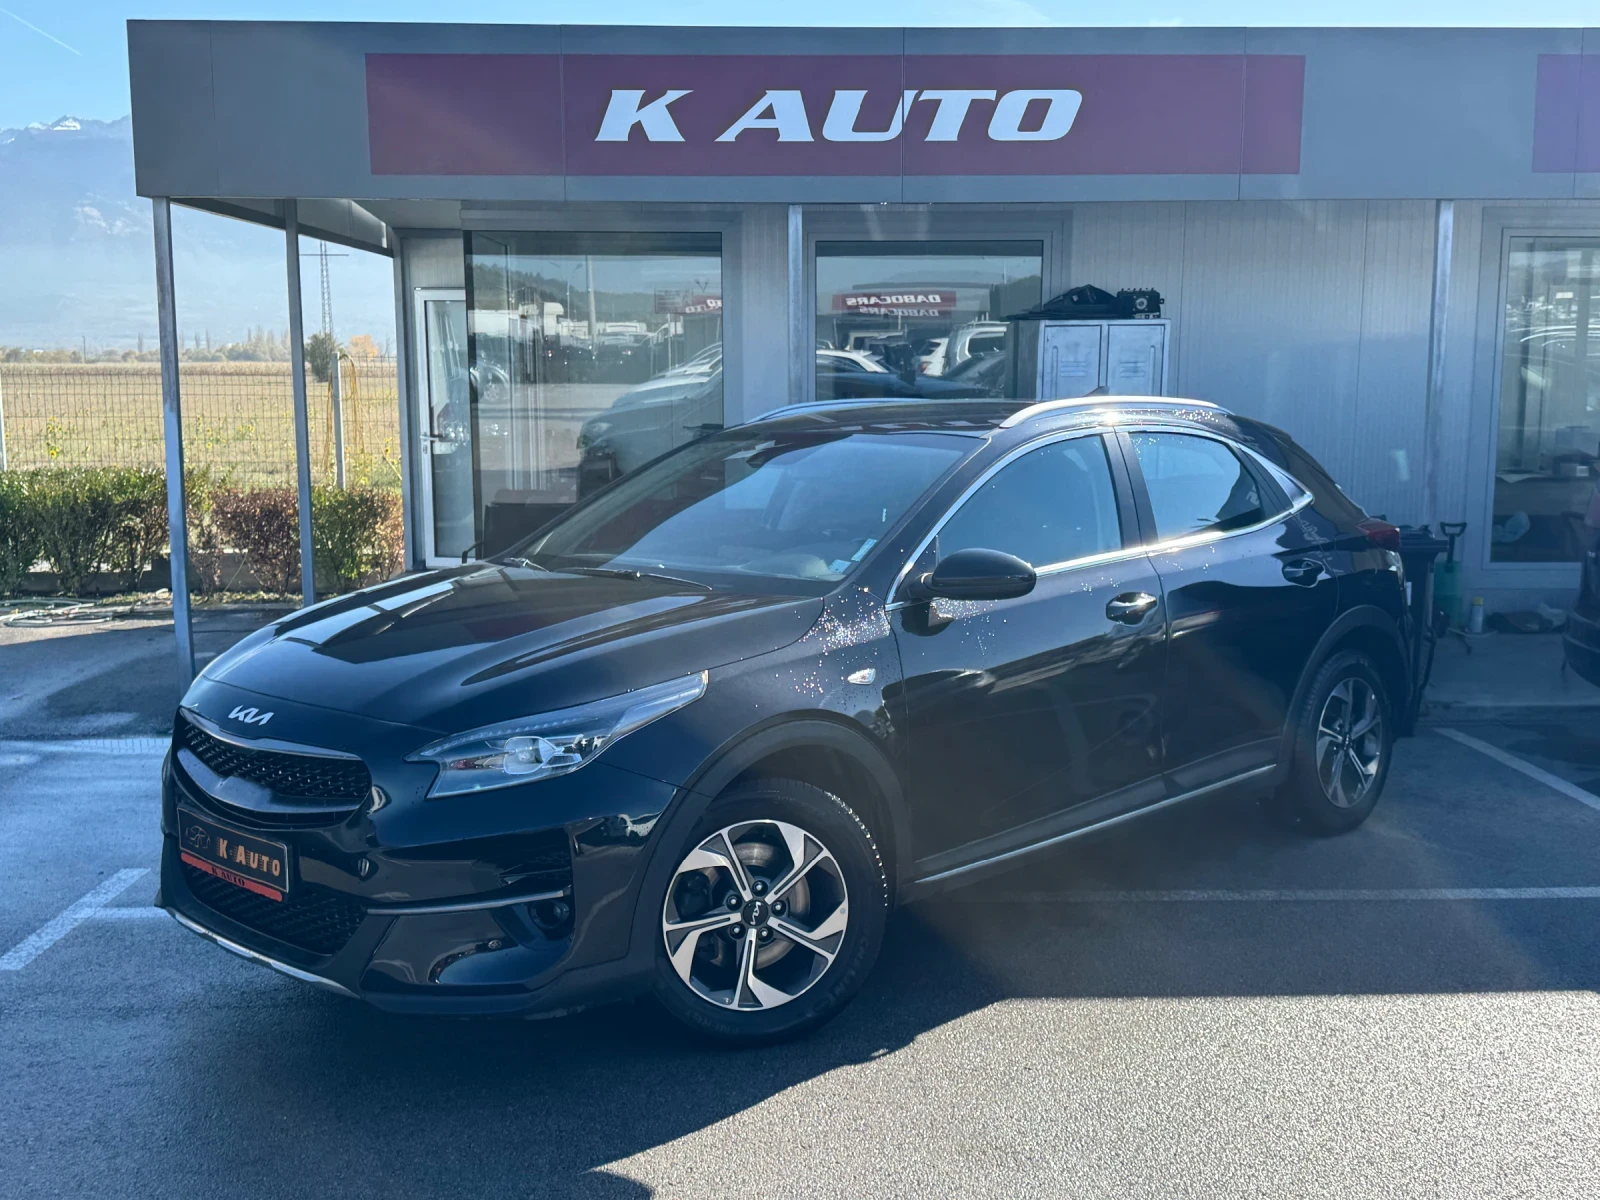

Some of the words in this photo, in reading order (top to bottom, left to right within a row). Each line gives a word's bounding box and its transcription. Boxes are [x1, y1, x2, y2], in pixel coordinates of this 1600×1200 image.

[594, 89, 694, 142] K
[714, 89, 1083, 142] AUTO
[228, 705, 274, 726] KIA
[217, 838, 229, 859] K
[235, 844, 281, 877] AUTO
[211, 866, 219, 876] K
[221, 870, 246, 887] AUTO
